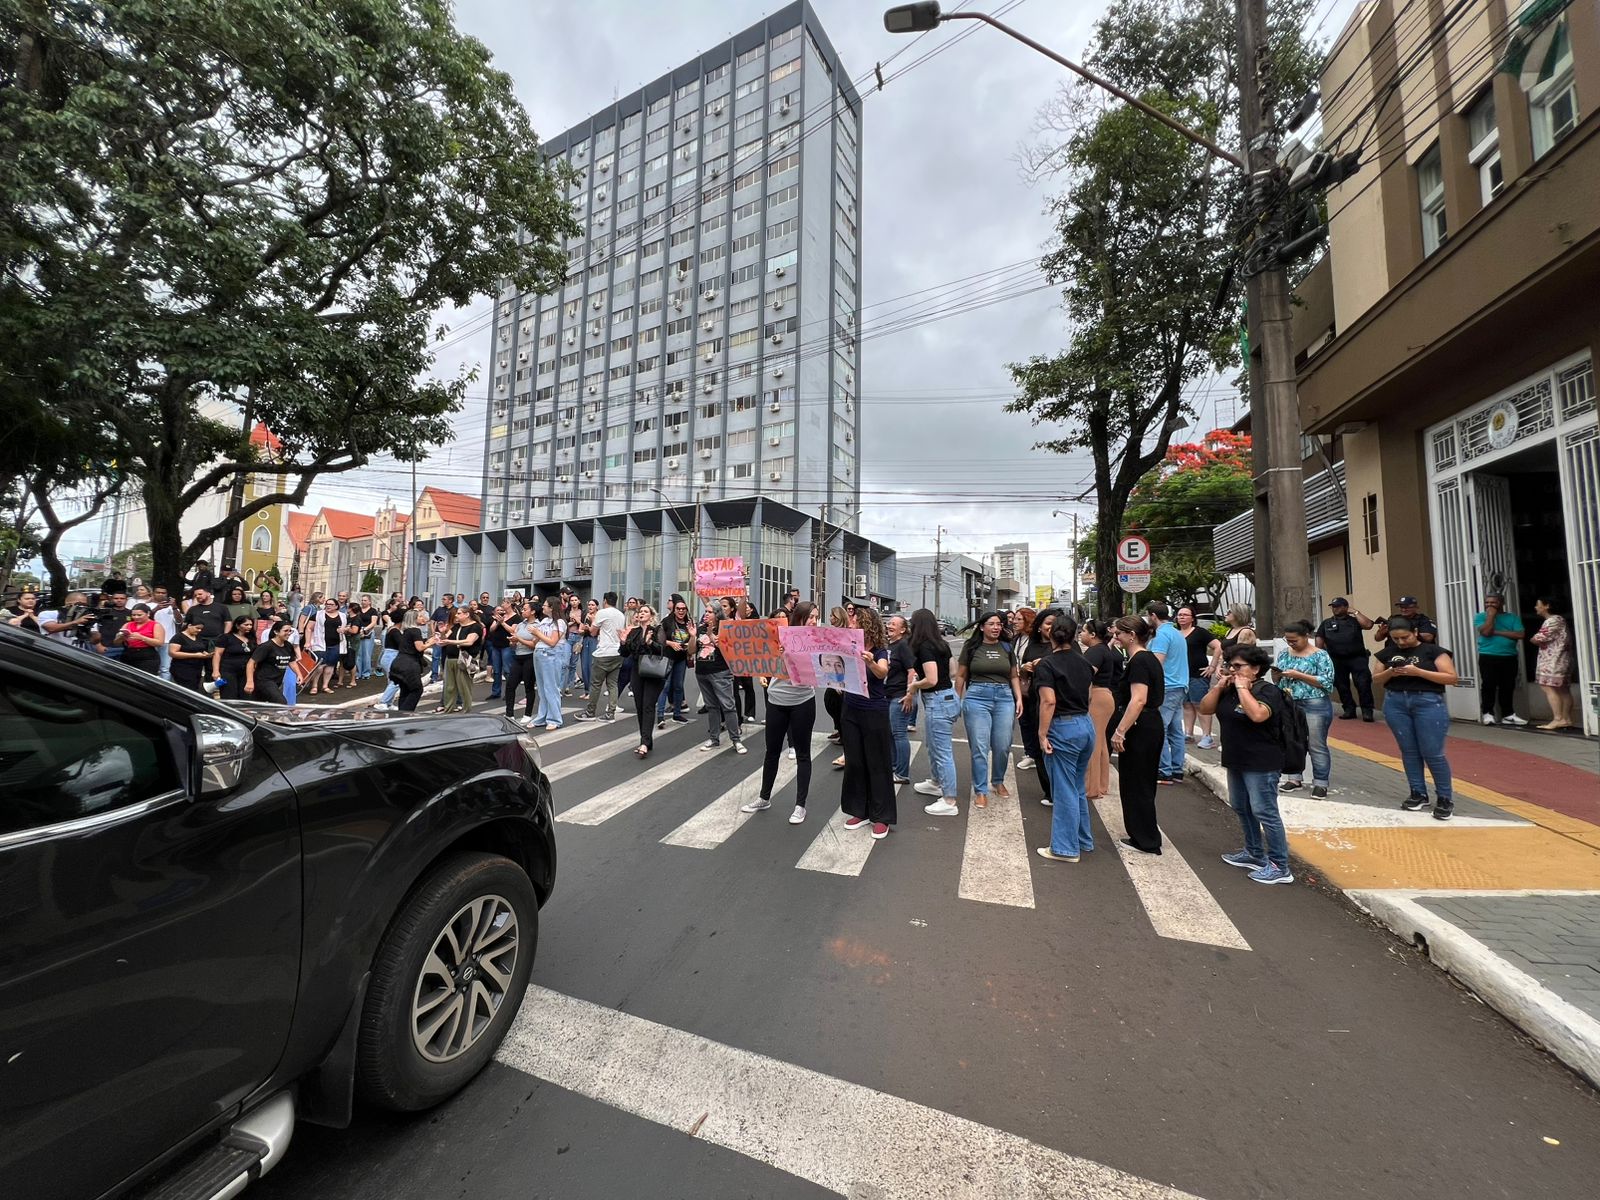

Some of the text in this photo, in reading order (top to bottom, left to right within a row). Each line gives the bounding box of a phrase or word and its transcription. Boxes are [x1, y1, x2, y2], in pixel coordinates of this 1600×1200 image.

[1127, 541, 1139, 558] E
[697, 558, 734, 572] GESTÃO
[723, 623, 769, 639] TODOS
[733, 641, 771, 656] PELA
